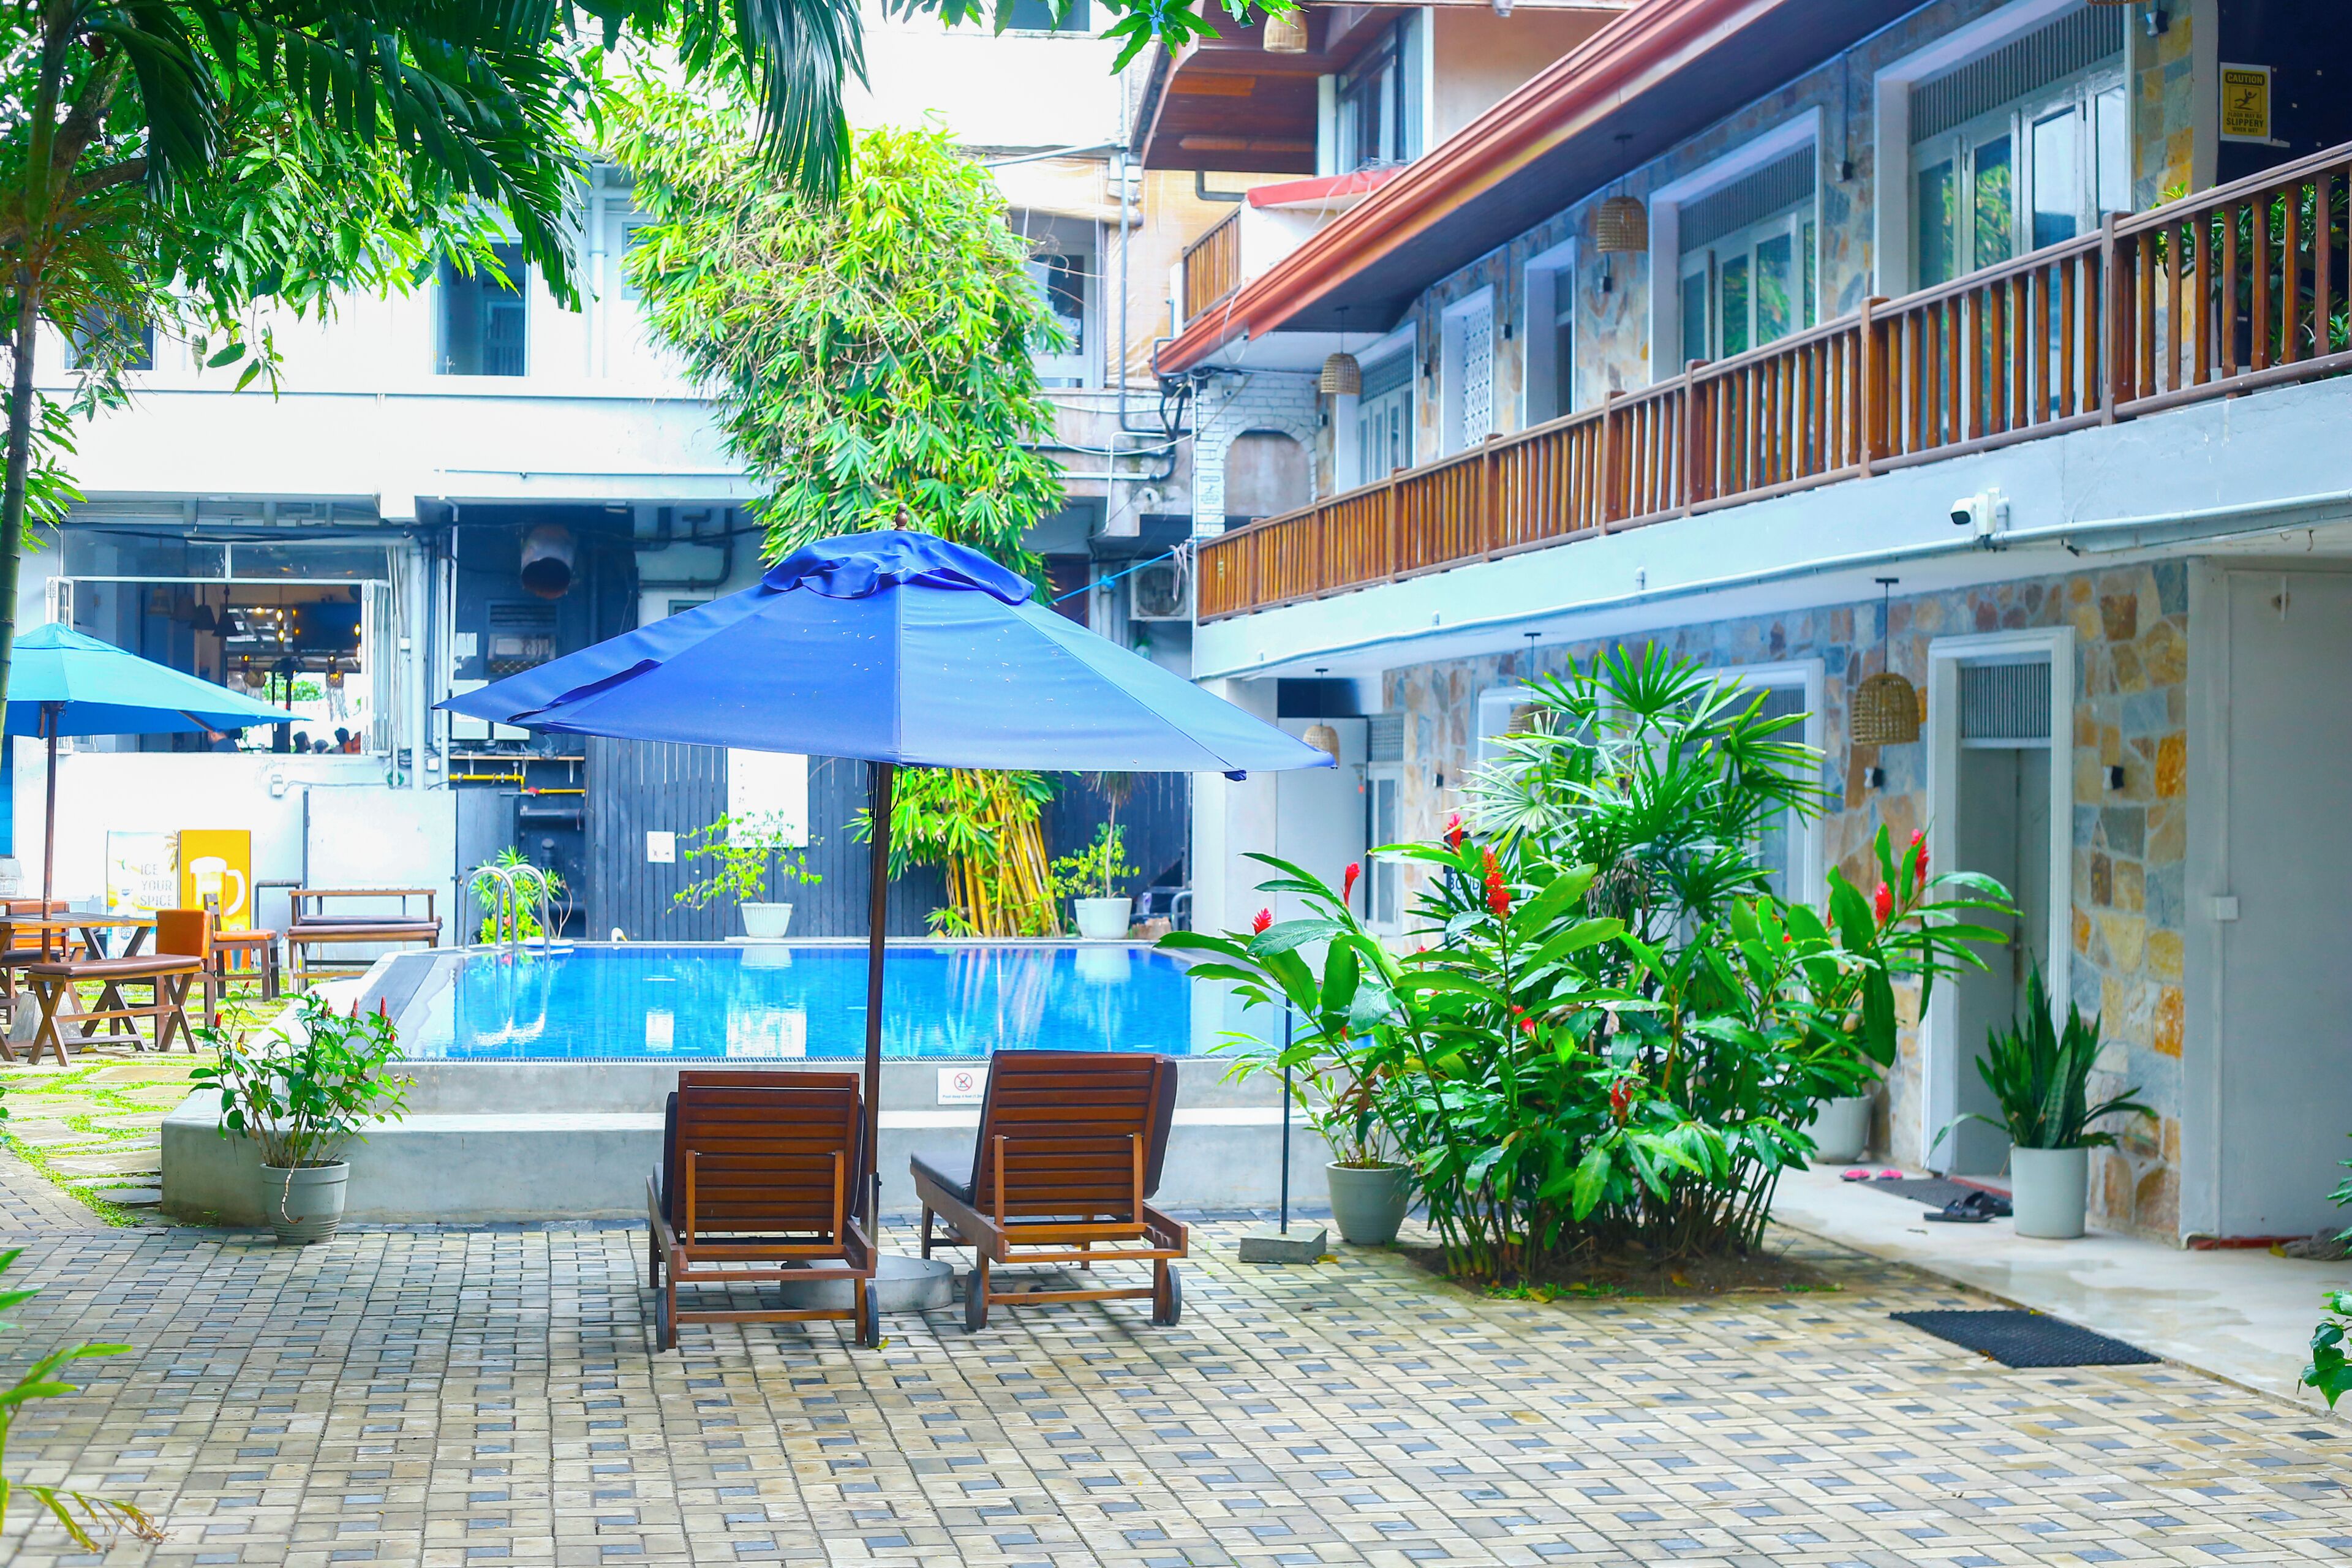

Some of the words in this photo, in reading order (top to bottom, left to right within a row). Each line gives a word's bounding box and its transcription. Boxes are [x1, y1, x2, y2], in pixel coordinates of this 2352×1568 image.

[2227, 74, 2263, 84] CAUTION
[2226, 118, 2264, 127] SLIPPERY
[141, 864, 158, 875] ICE
[141, 880, 172, 891] YOUR
[140, 895, 173, 907] SPICE
